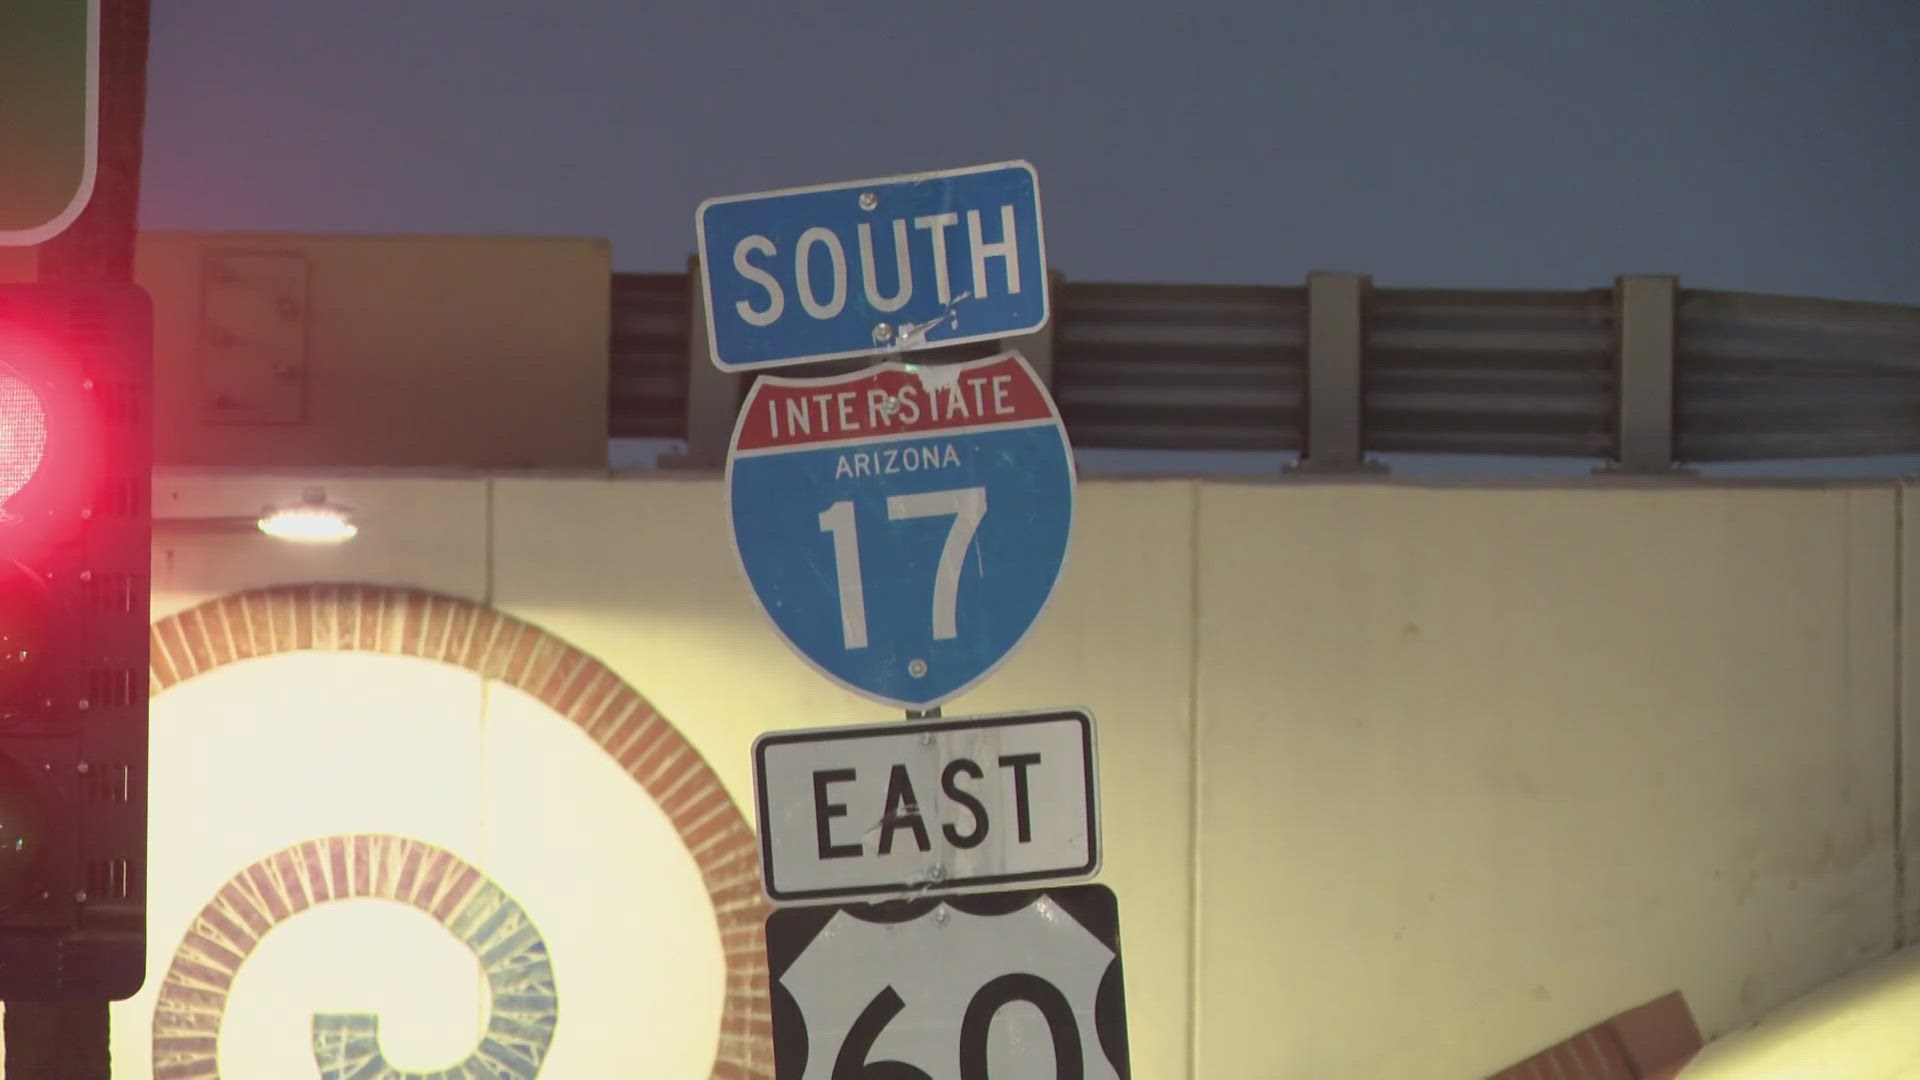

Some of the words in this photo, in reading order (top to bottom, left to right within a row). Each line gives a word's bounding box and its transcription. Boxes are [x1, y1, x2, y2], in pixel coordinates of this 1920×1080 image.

[733, 205, 1020, 327] SOUTH
[769, 375, 1015, 439] INTERSTATE
[835, 443, 960, 480] ARIZONA
[819, 486, 988, 649] 17
[812, 752, 1041, 860] EAST
